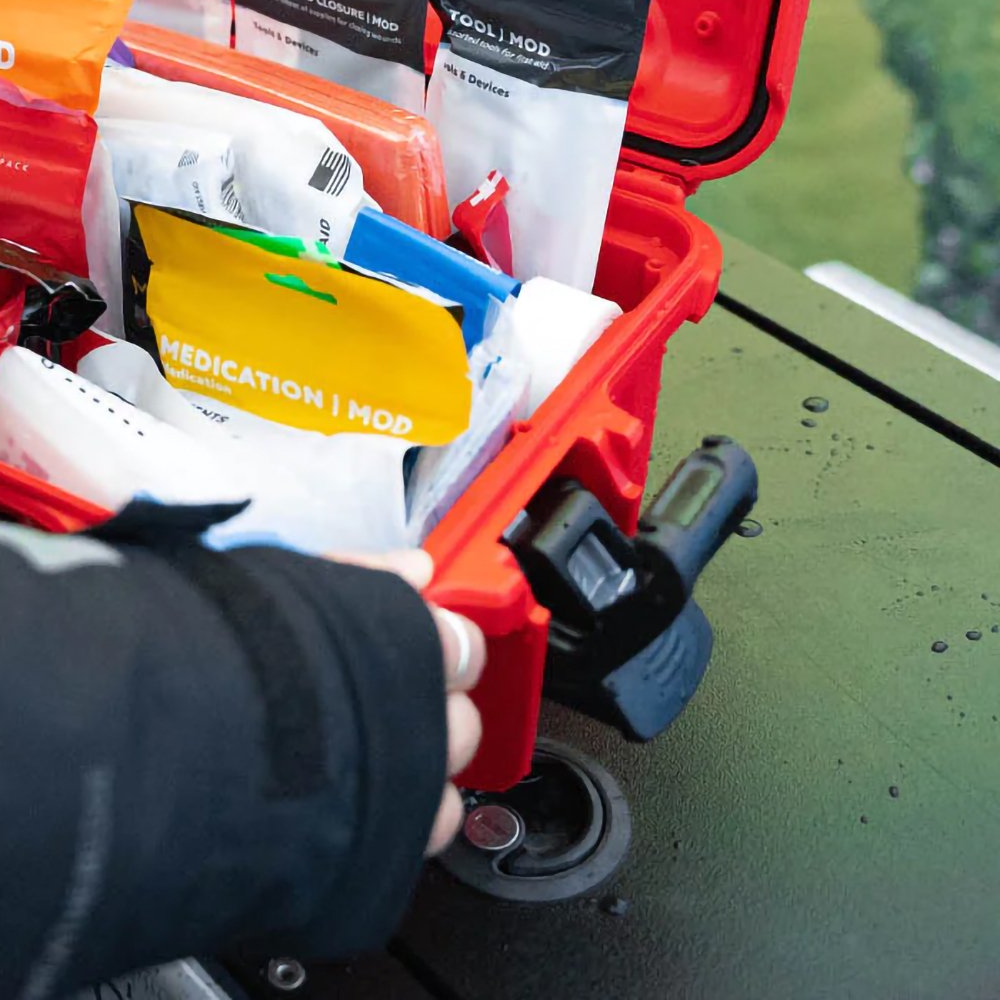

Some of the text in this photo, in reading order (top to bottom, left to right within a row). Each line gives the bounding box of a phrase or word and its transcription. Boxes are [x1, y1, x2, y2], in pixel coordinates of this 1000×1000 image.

[372, 14, 400, 32] MOD
[449, 9, 497, 38] TOOL
[509, 31, 551, 57] MOD
[285, 36, 319, 56] Devices
[501, 47, 515, 59] for
[468, 74, 510, 98] Devices
[318, 218, 331, 246] AID
[160, 334, 323, 409] MEDICATION
[348, 399, 413, 436] MOD
